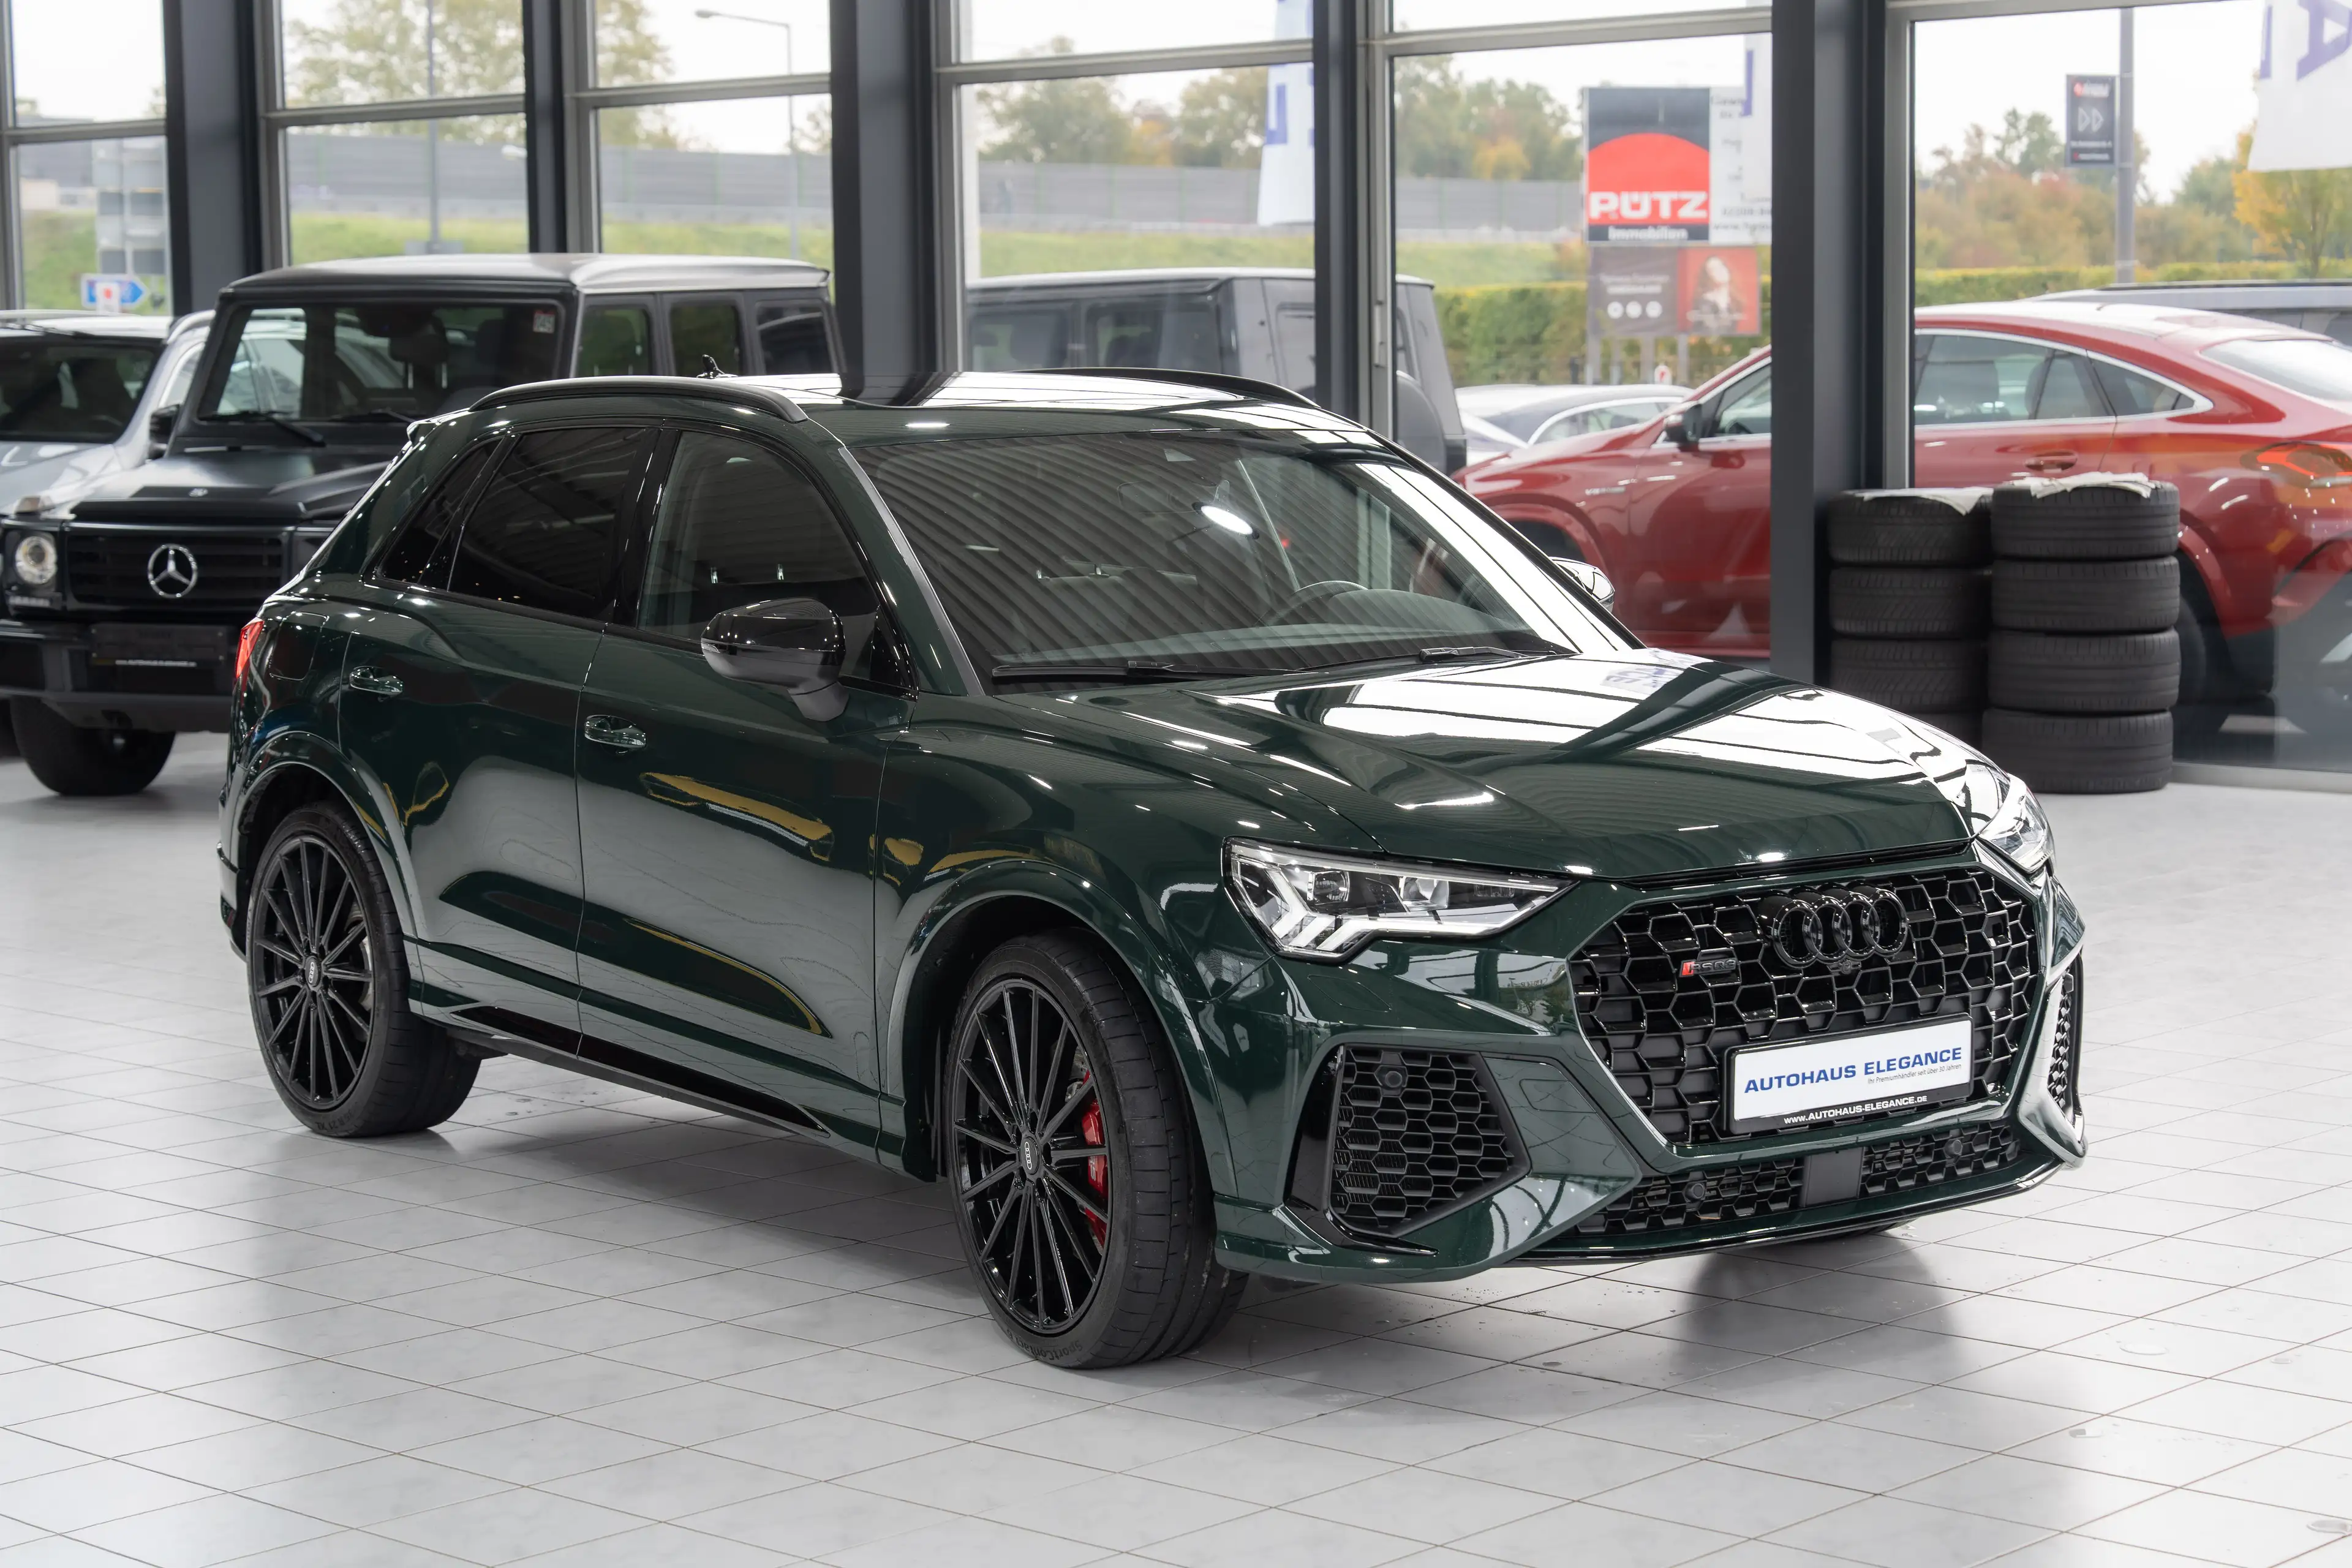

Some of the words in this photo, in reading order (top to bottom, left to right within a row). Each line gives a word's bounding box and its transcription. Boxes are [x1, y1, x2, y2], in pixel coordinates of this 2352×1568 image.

[1589, 191, 1708, 219] PÜTZ
[1744, 1065, 1856, 1093] AUTOHAUS
[1864, 1047, 1962, 1075] ELEGANCE
[1875, 1071, 1917, 1083] Premiumhändler
[1015, 1335, 1083, 1360] SportContact
